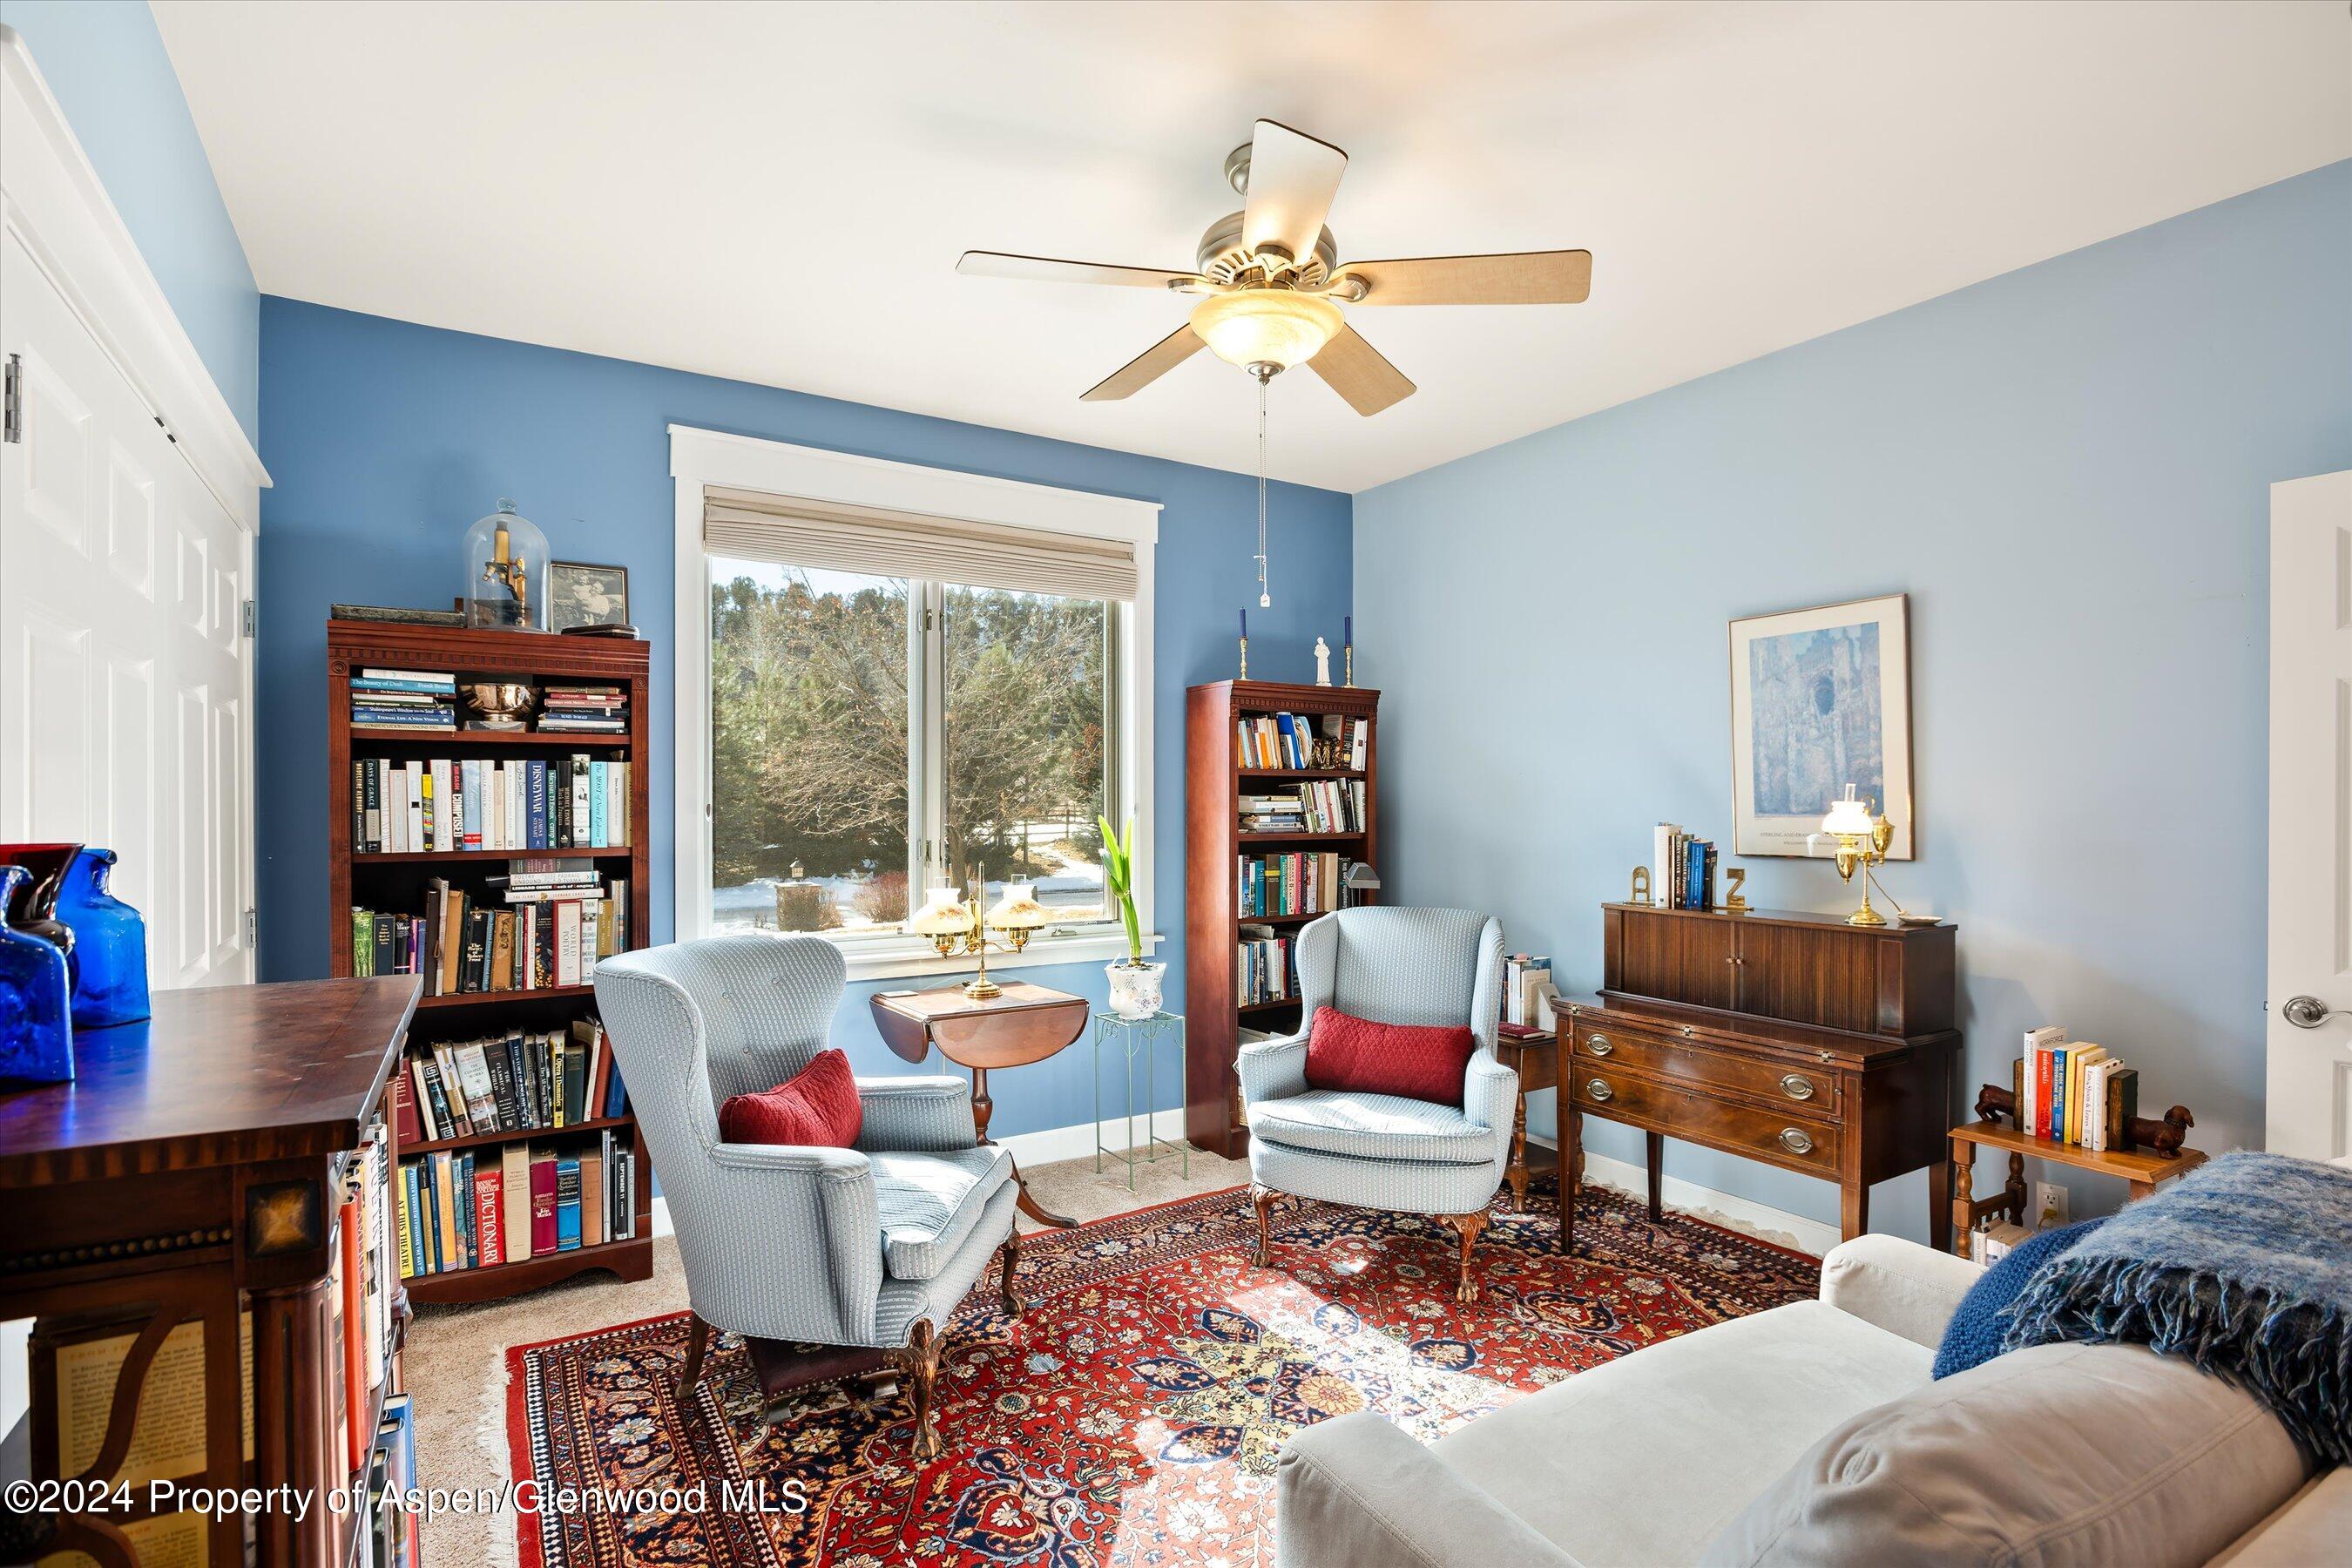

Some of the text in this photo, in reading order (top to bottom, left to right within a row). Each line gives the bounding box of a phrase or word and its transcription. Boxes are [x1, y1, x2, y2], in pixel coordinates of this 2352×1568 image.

[533, 765, 543, 813] DISNEYWAR
[452, 794, 463, 838] COMPOSED
[548, 822, 557, 838] camp
[490, 1069, 499, 1091] WORLD
[496, 1061, 506, 1095] CLASSICAL
[398, 1200, 410, 1270] AT THIS THEATRE
[481, 1193, 499, 1264] DICTIONARY
